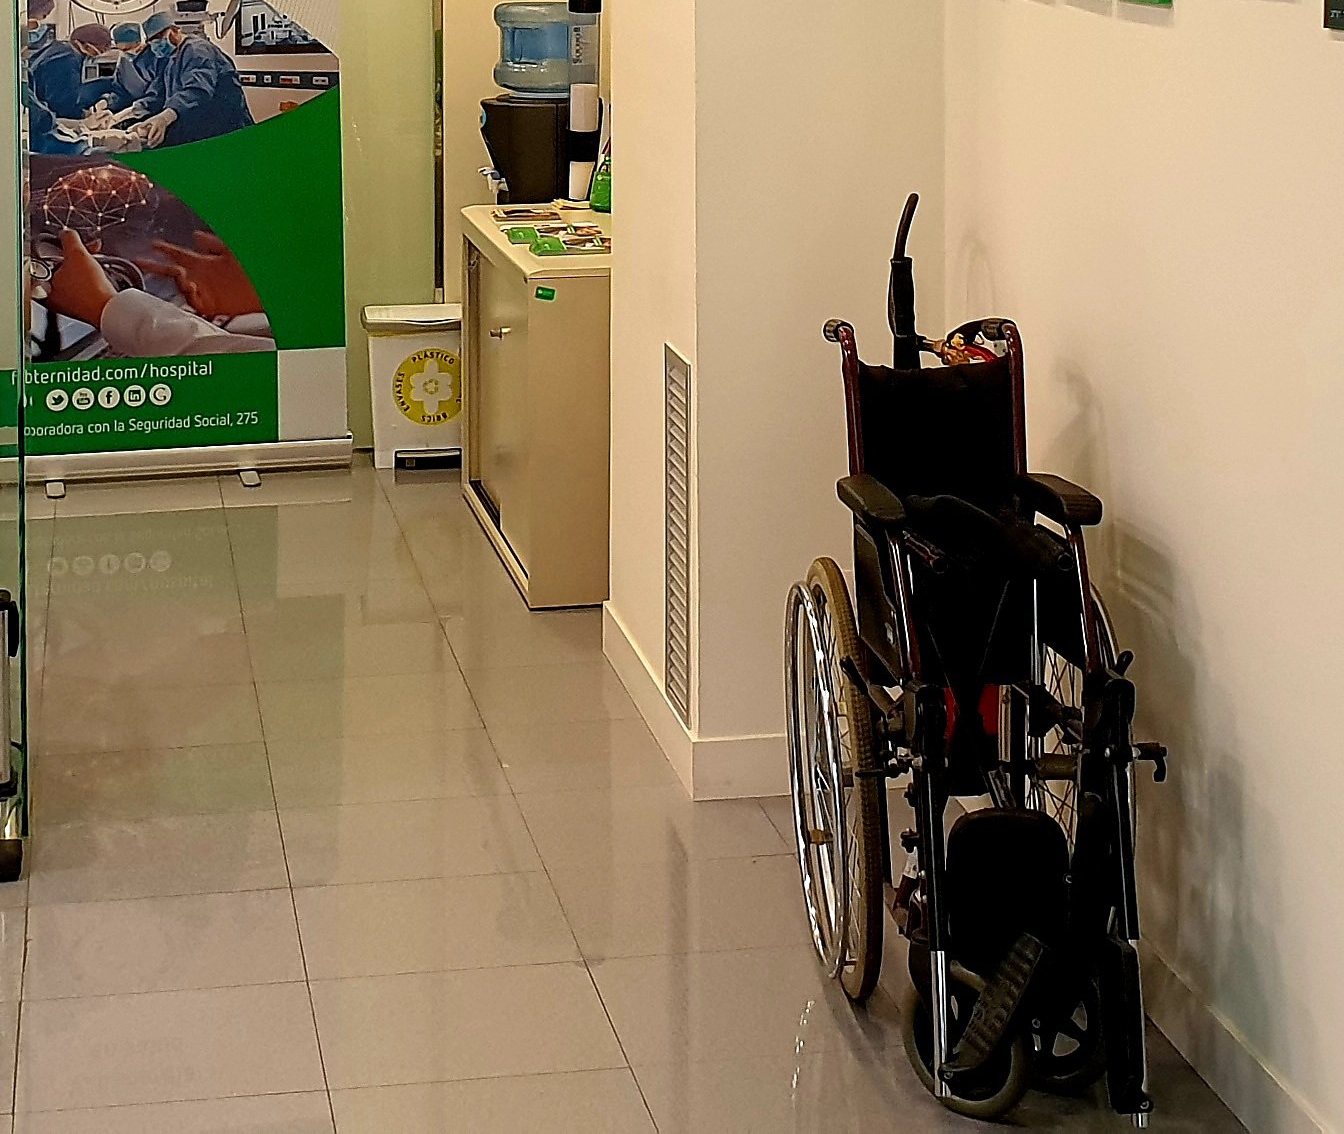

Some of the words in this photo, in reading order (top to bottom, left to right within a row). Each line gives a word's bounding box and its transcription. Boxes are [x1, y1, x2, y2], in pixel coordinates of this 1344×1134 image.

[395, 372, 411, 412] ENVASES
[87, 423, 110, 433] con
[114, 420, 125, 432] la
[129, 416, 191, 434] Seguridad
[194, 414, 233, 428] Social,
[237, 412, 258, 425] 275
[421, 412, 448, 424] BRICS
